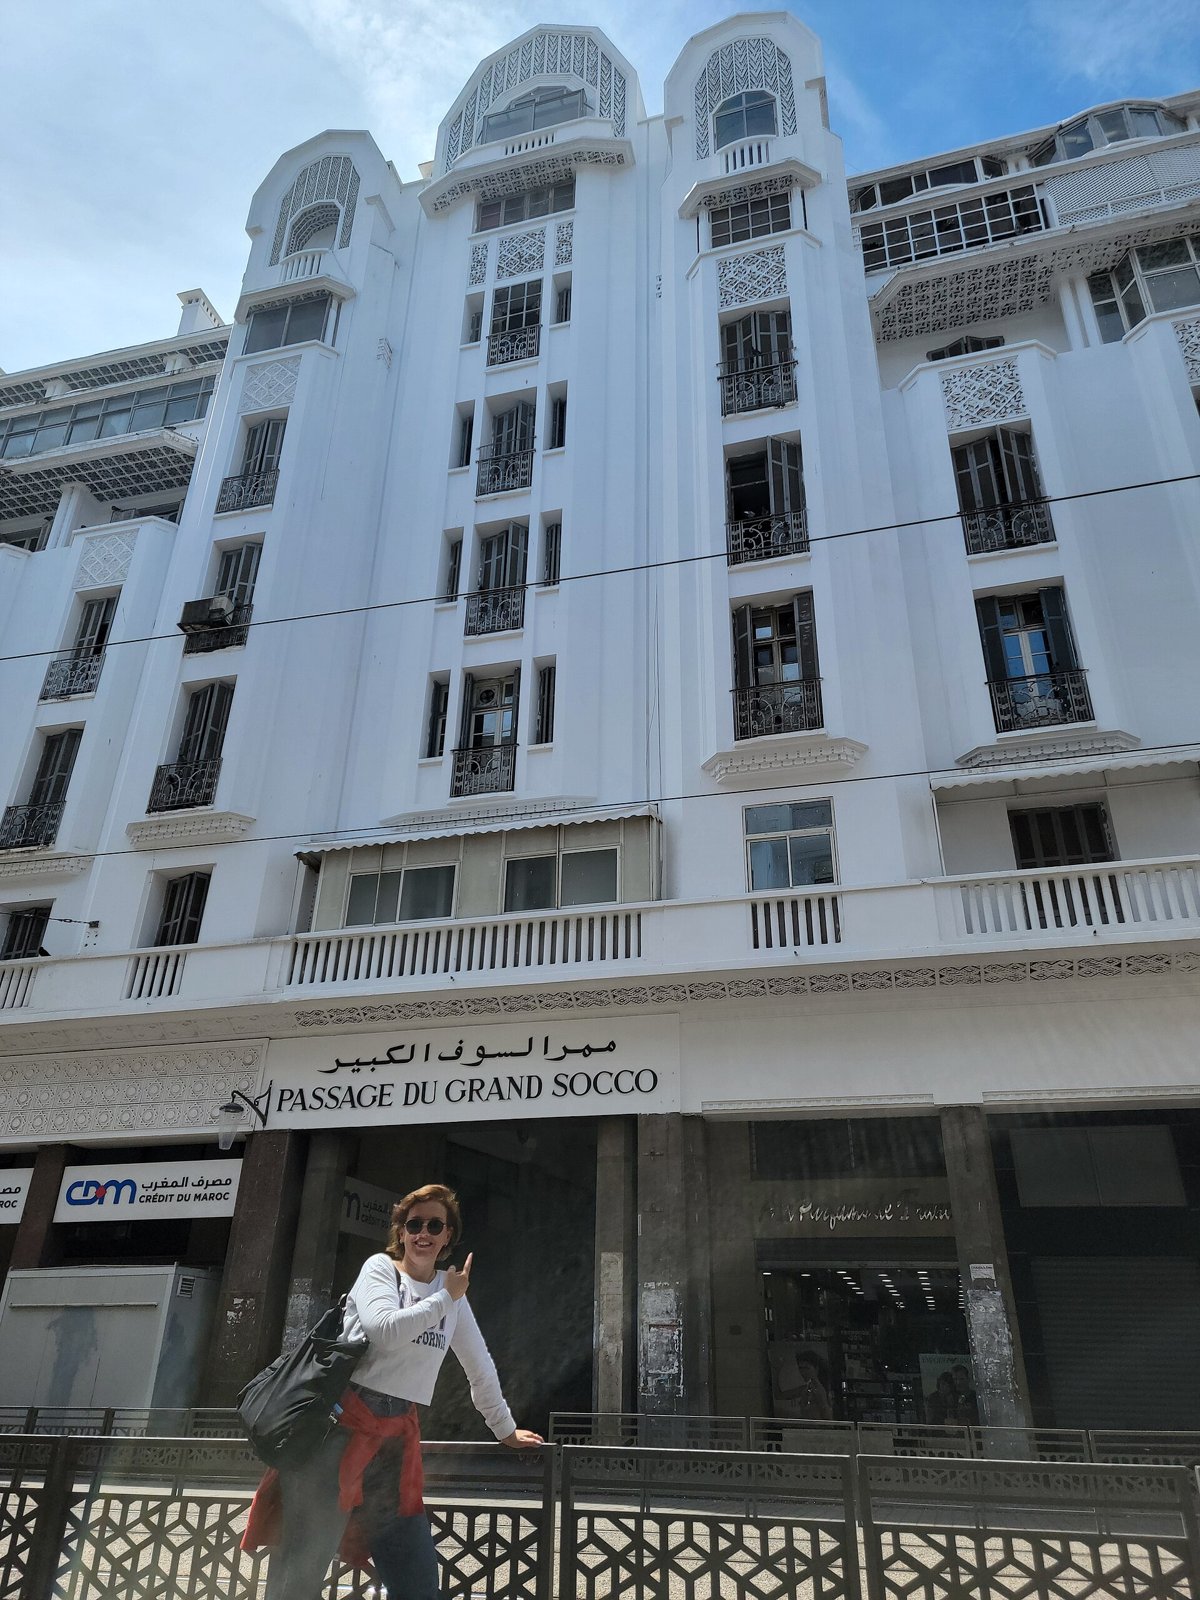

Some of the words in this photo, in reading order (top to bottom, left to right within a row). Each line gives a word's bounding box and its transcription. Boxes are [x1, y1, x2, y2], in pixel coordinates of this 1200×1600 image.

[317, 1042, 432, 1074] الكبير
[276, 1083, 394, 1112] PASSAGE
[402, 1080, 438, 1107] DU
[445, 1074, 543, 1104] GRAND
[551, 1068, 658, 1098] SOCCO
[141, 1176, 189, 1192] المغرب
[191, 1176, 232, 1190] مصرف
[0, 1200, 18, 1209] ROC
[138, 1193, 175, 1203] CRÉDIT
[176, 1193, 191, 1203] DU
[193, 1192, 230, 1202] MAROC
